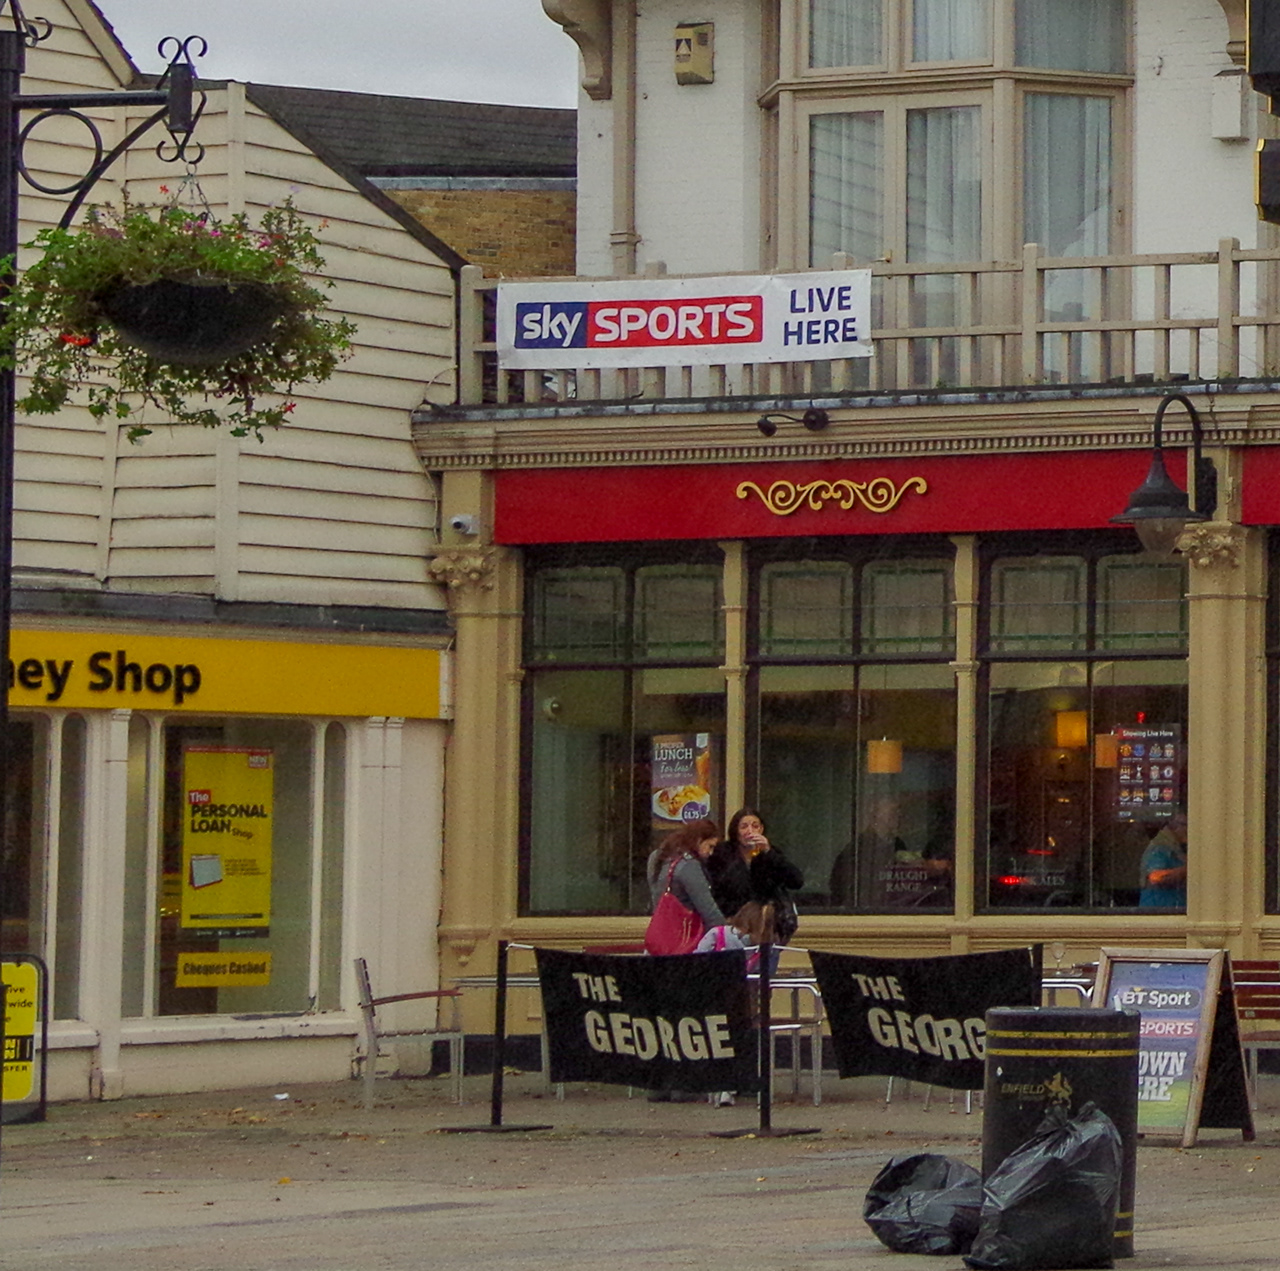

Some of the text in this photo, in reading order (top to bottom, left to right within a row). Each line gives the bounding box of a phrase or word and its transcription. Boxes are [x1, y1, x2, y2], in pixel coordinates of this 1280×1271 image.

[789, 285, 852, 313] LIVE
[522, 303, 754, 347] sky SPORTS
[783, 317, 858, 347] HERE
[8, 650, 202, 706] ey Shop
[654, 748, 693, 760] LUNCH
[190, 791, 209, 802] The
[191, 803, 267, 818] PERSONAL
[191, 819, 254, 840] LOAN Shop
[183, 961, 266, 976] Cheques Cashed
[572, 972, 622, 1003] THE
[851, 973, 905, 1002] THE
[1121, 990, 1192, 1008] BT Sport
[584, 1009, 735, 1062] GEORGE
[867, 1007, 986, 1062] GEORG
[1139, 1021, 1194, 1035] SPORTS
[1001, 1083, 1045, 1094] ENFIELD
